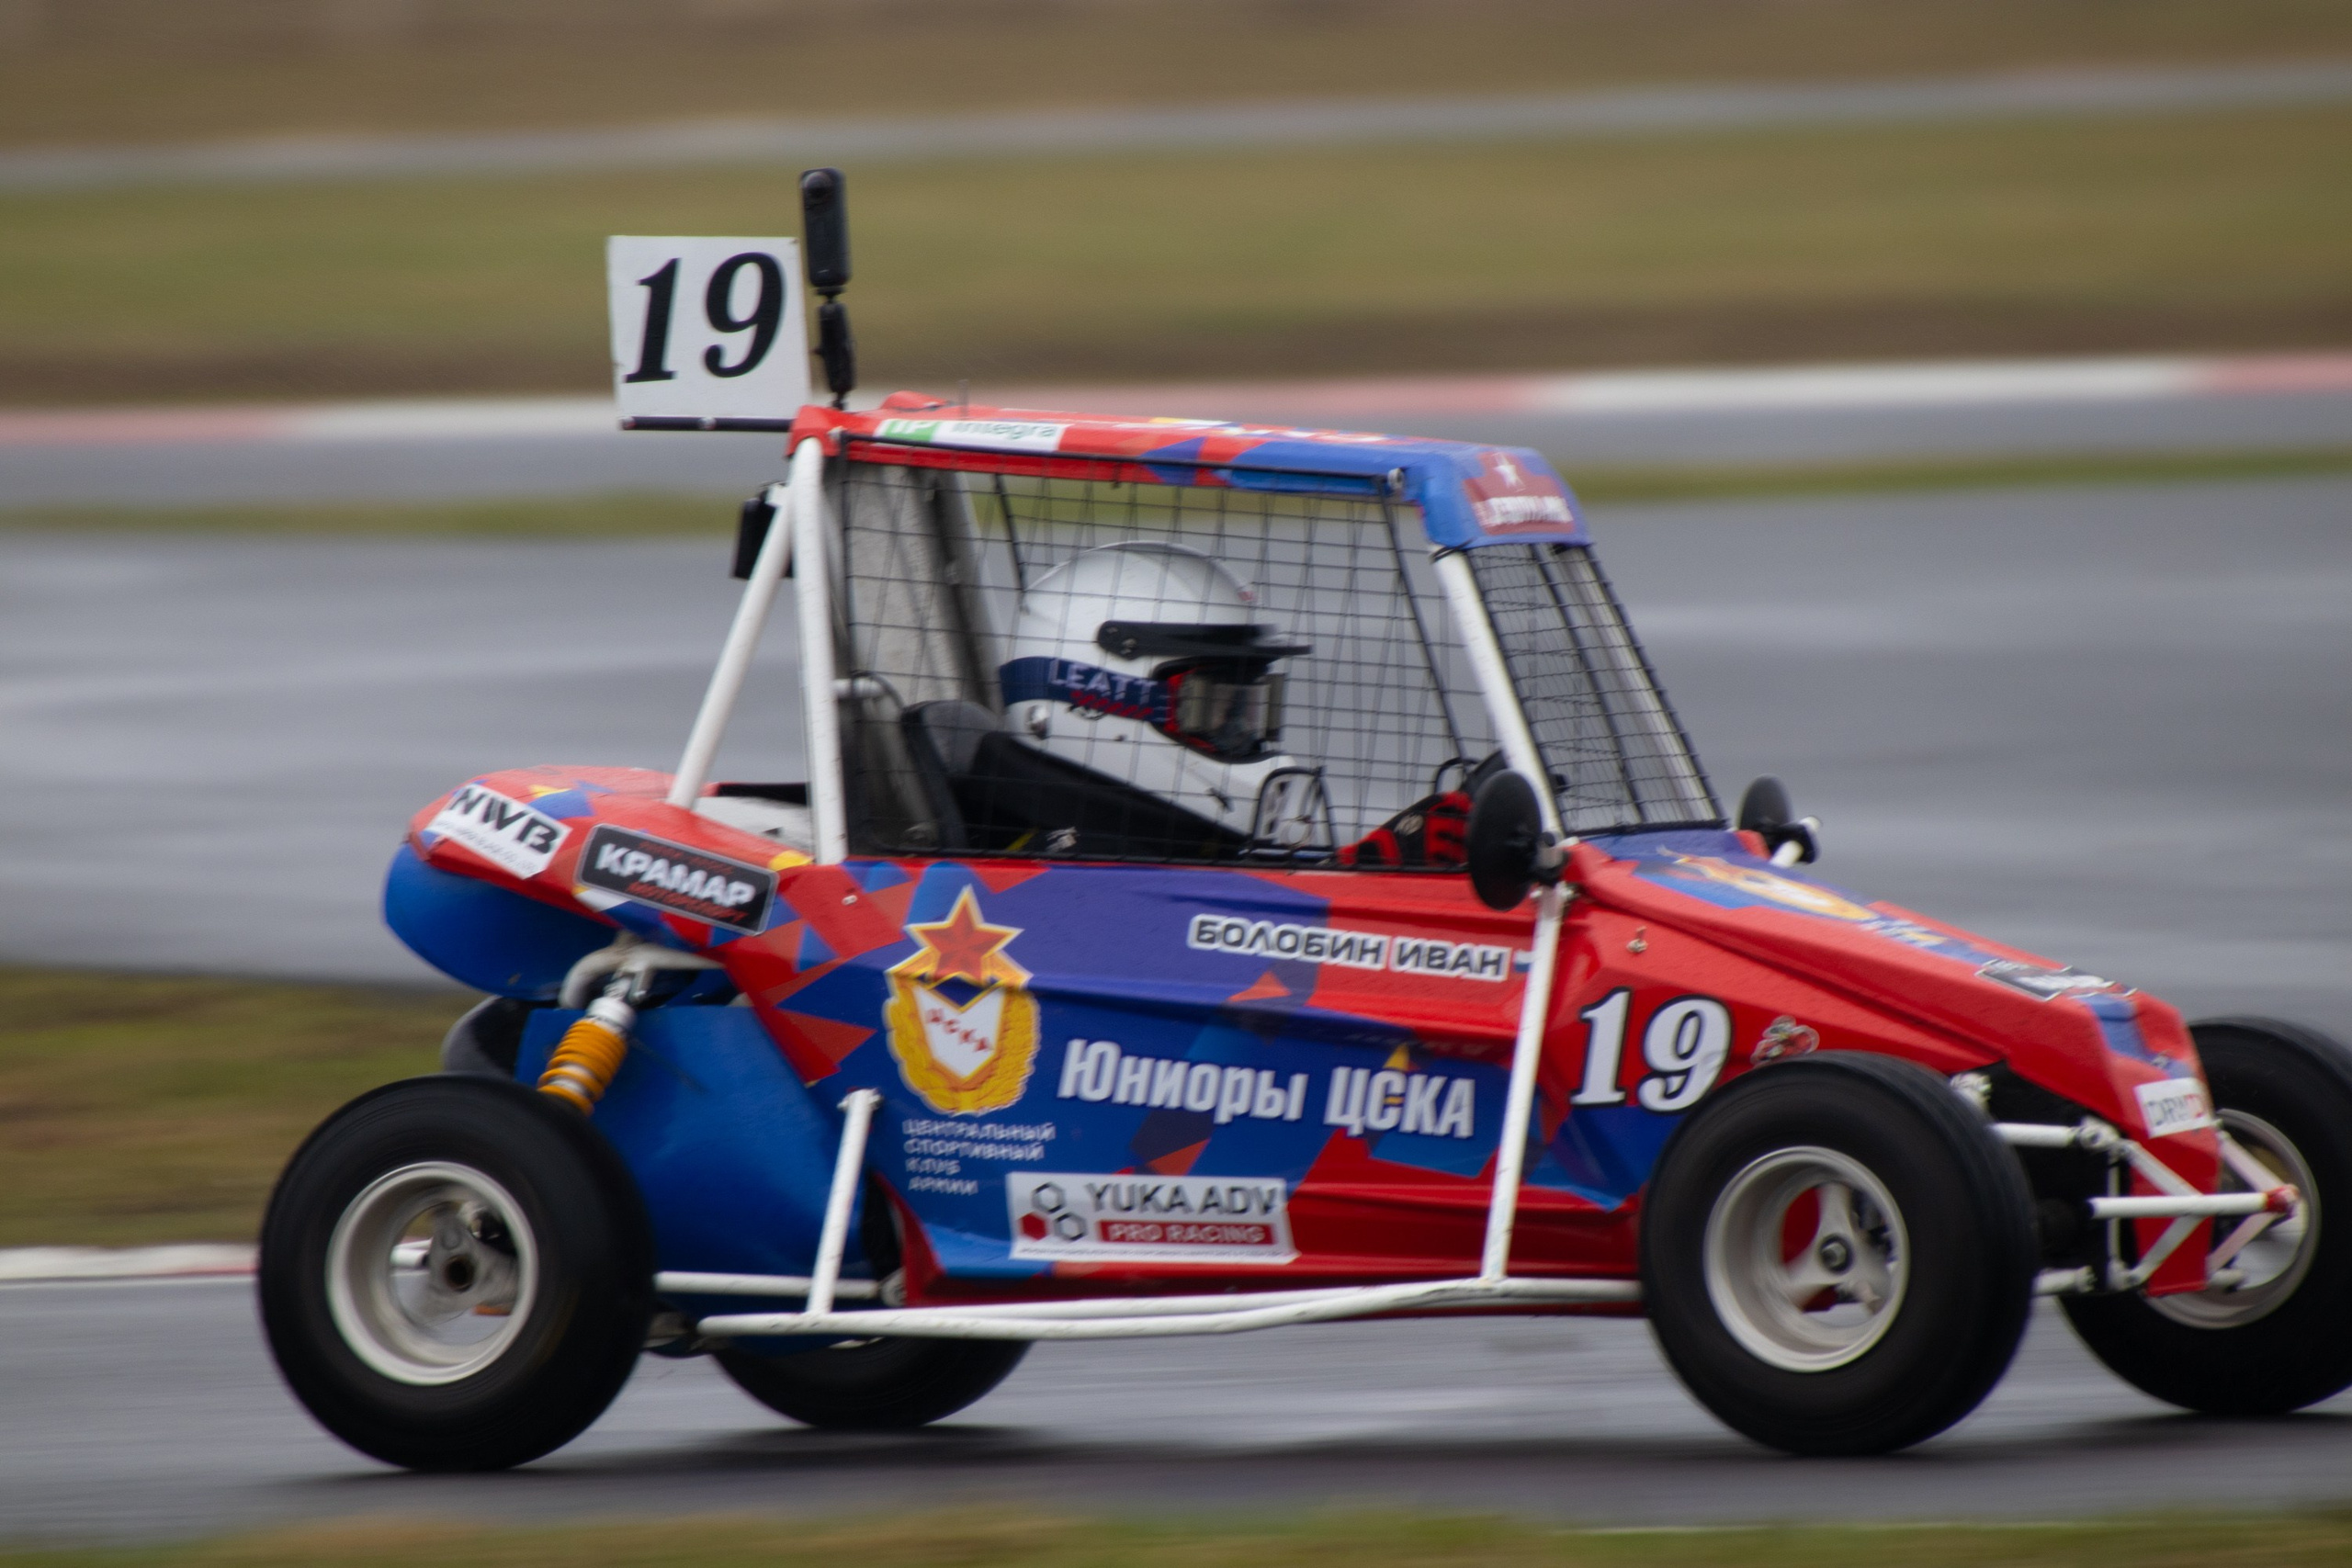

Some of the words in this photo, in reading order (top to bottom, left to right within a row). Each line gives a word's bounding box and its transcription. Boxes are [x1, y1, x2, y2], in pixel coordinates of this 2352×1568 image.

[623, 252, 786, 383] 19
[1047, 659, 1158, 705] LEATT
[595, 843, 756, 907] КРАМАР
[1194, 919, 1382, 965] БОЛОБИН
[1395, 941, 1505, 977] ИВАН
[1570, 986, 1734, 1116] 19
[1057, 1038, 1308, 1124] Юниоры
[1323, 1066, 1476, 1139] ЦСКА
[902, 1119, 1056, 1142] ЦЕНТРАЛЬНЫЙ
[903, 1138, 1045, 1162] СПОРТИВНЫЙ
[905, 1157, 961, 1175] КЛУБ
[908, 1176, 978, 1195] АРМИИ
[1085, 1182, 1193, 1213] YUKA
[1198, 1185, 1278, 1215] ADV
[1107, 1223, 1163, 1242] PRO
[1165, 1224, 1266, 1244] RACING
